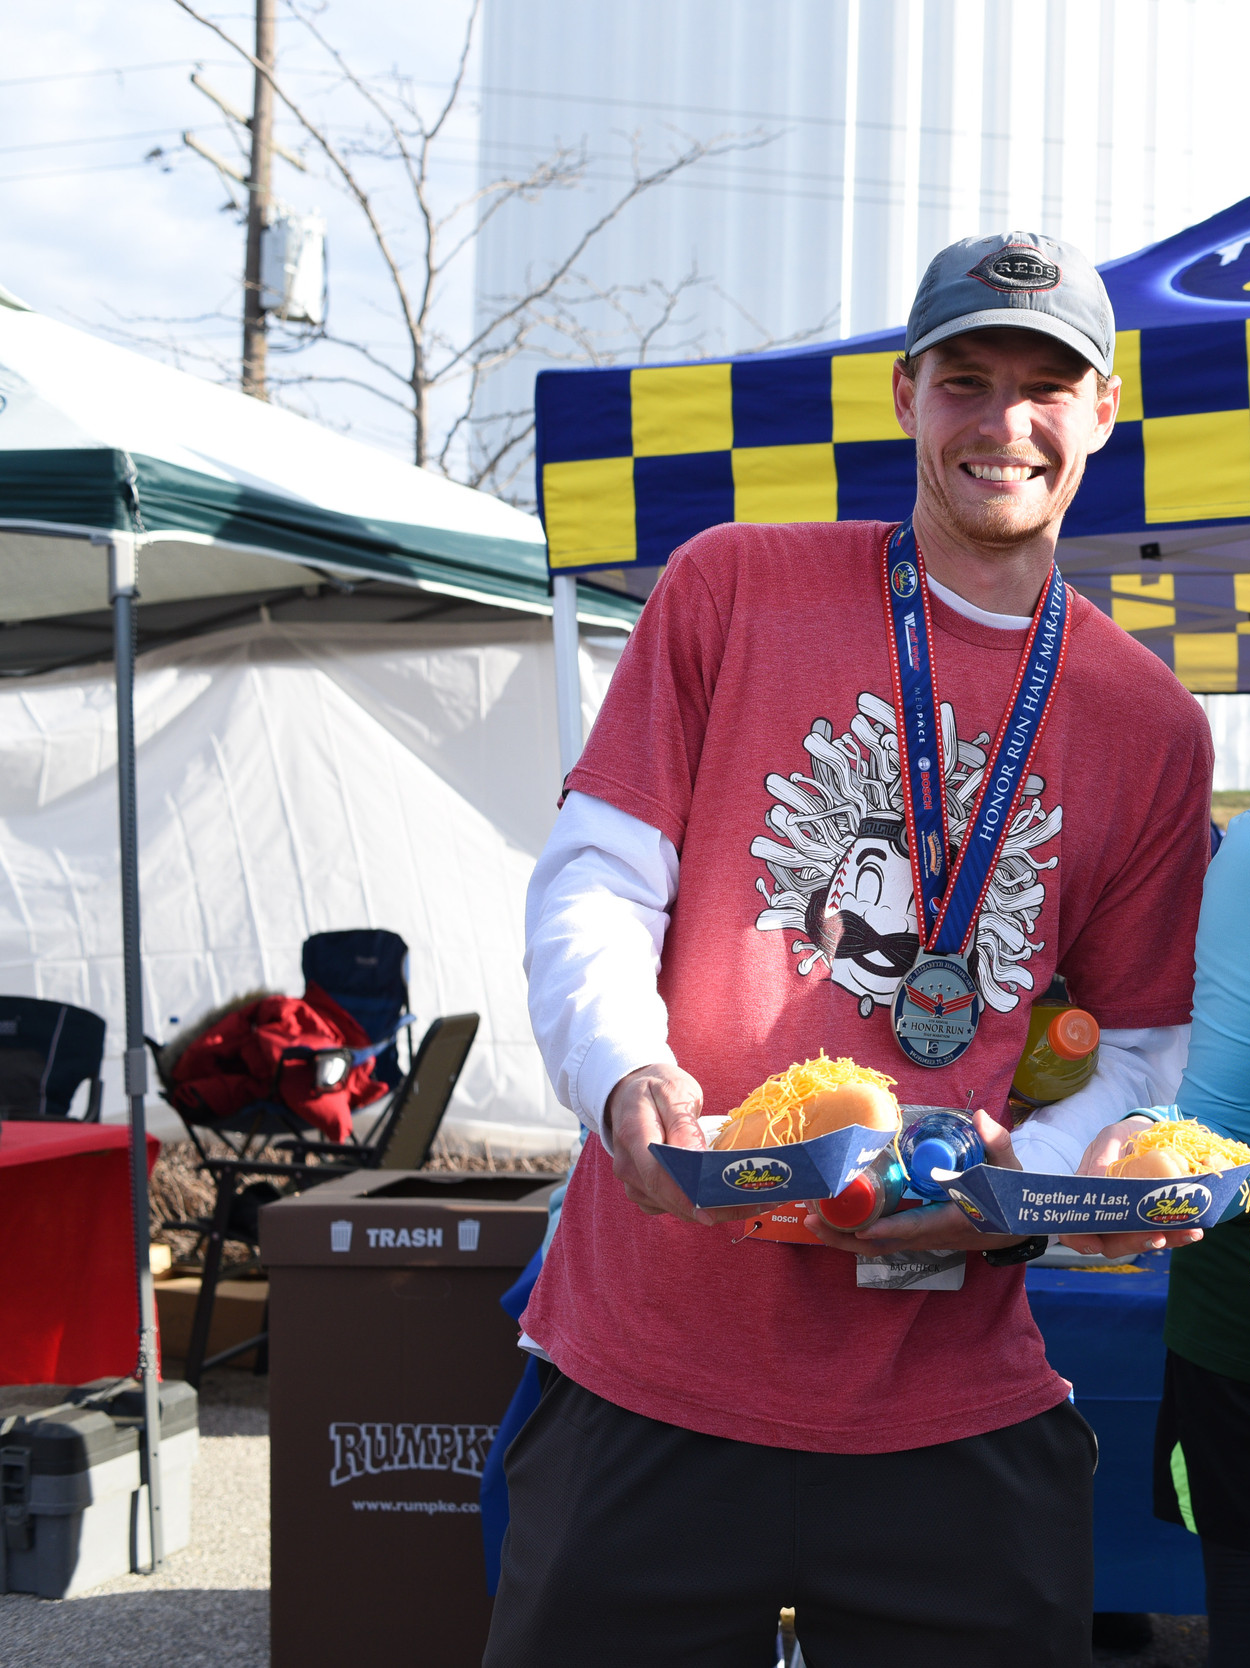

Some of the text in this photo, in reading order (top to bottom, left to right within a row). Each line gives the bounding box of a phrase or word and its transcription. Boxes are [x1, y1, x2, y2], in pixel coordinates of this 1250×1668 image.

[997, 262, 1057, 279] REDS
[910, 645, 920, 671] Wyler
[915, 687, 926, 743] MEDPACE
[980, 765, 1016, 841] HONOR
[1007, 716, 1031, 759] RUN
[1023, 661, 1048, 712] HALF
[921, 772, 932, 810] BOSCH
[911, 1022, 964, 1035] HONOR RUN
[735, 1170, 783, 1189] Skyline
[1022, 1188, 1130, 1206] Together At Last,
[771, 1214, 798, 1223] BOSCH
[1018, 1207, 1129, 1224] It's Skyline Time!
[1146, 1199, 1199, 1223] Skyline
[367, 1228, 443, 1247] TRASH
[890, 1262, 941, 1272] BAG CHECK
[329, 1422, 500, 1487] RUMPK
[352, 1500, 482, 1515] www.rumpke.co
